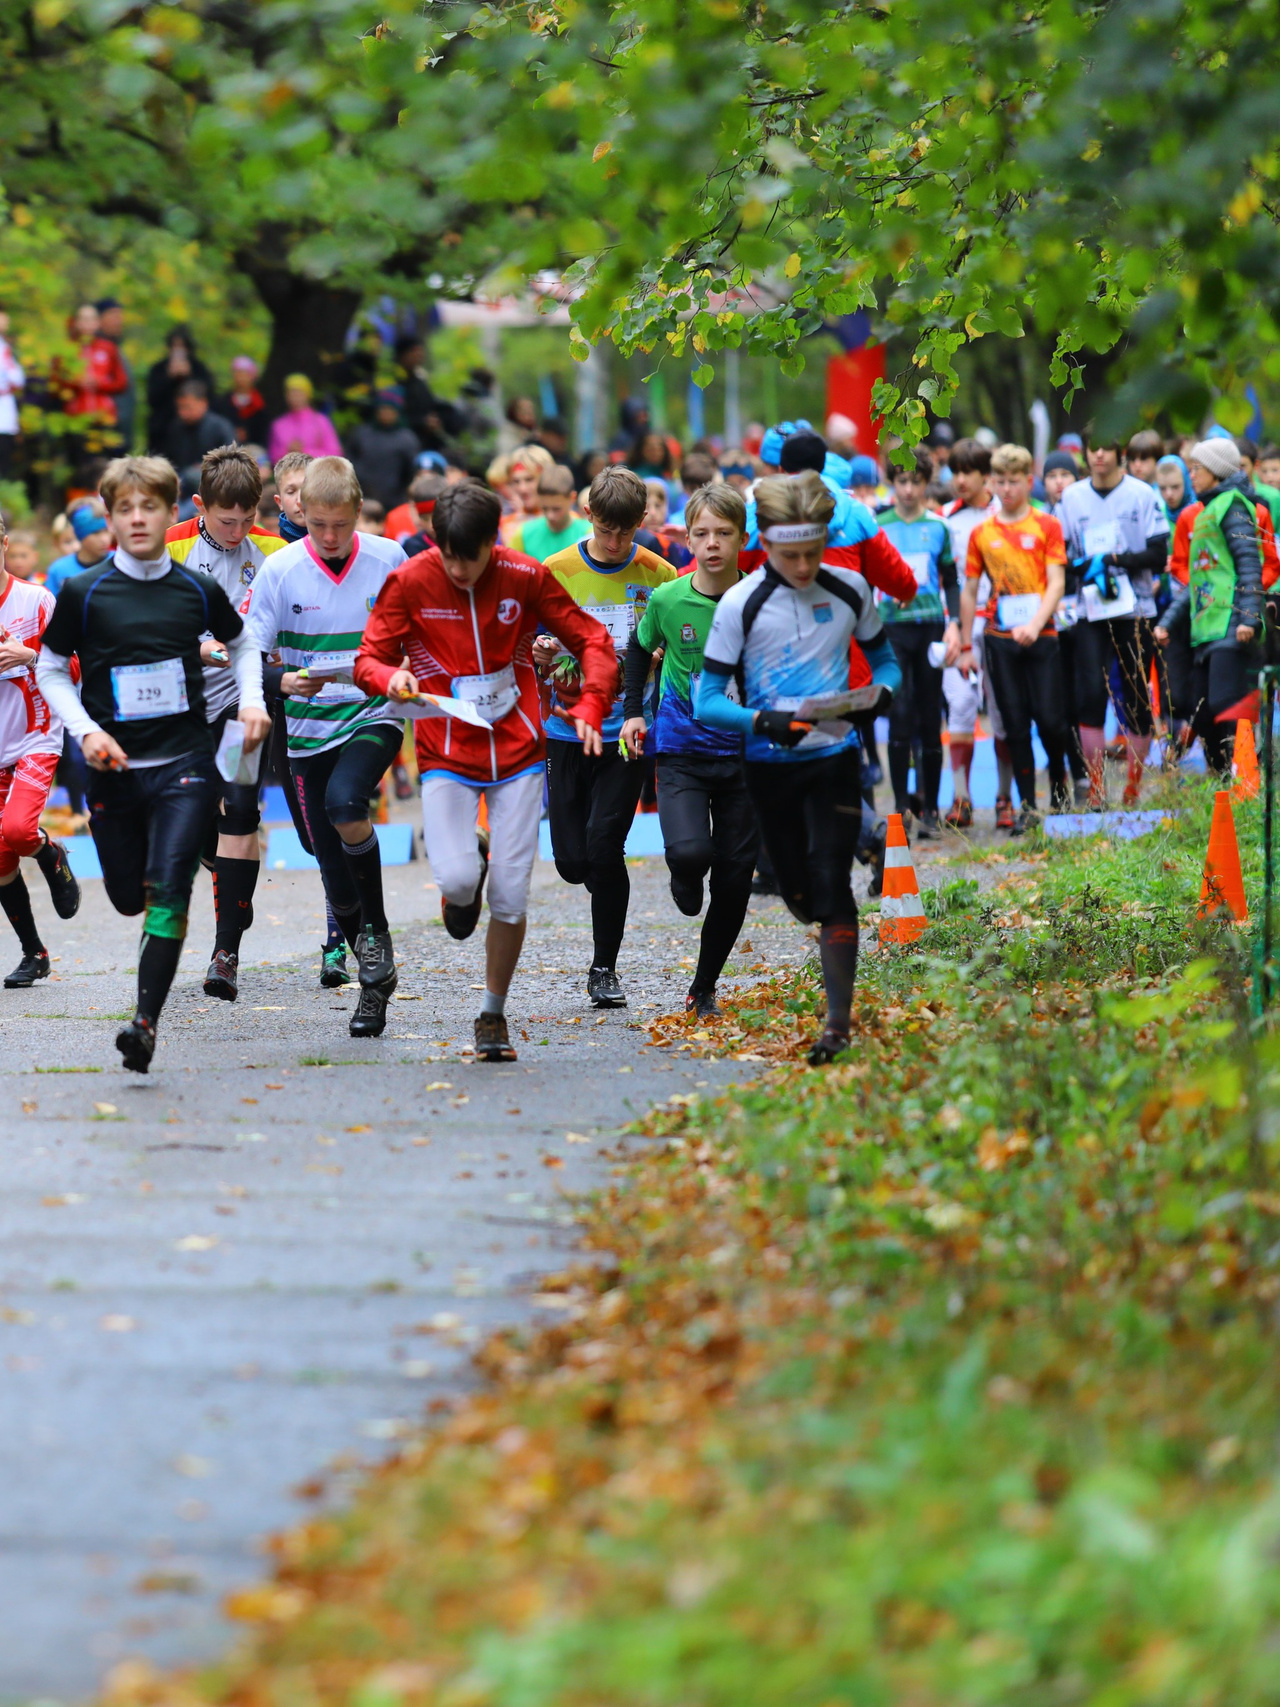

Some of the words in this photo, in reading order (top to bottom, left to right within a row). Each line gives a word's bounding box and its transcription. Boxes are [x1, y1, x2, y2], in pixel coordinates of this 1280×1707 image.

[136, 687, 162, 701] 229
[477, 691, 500, 706] 225
[32, 694, 47, 728] think
